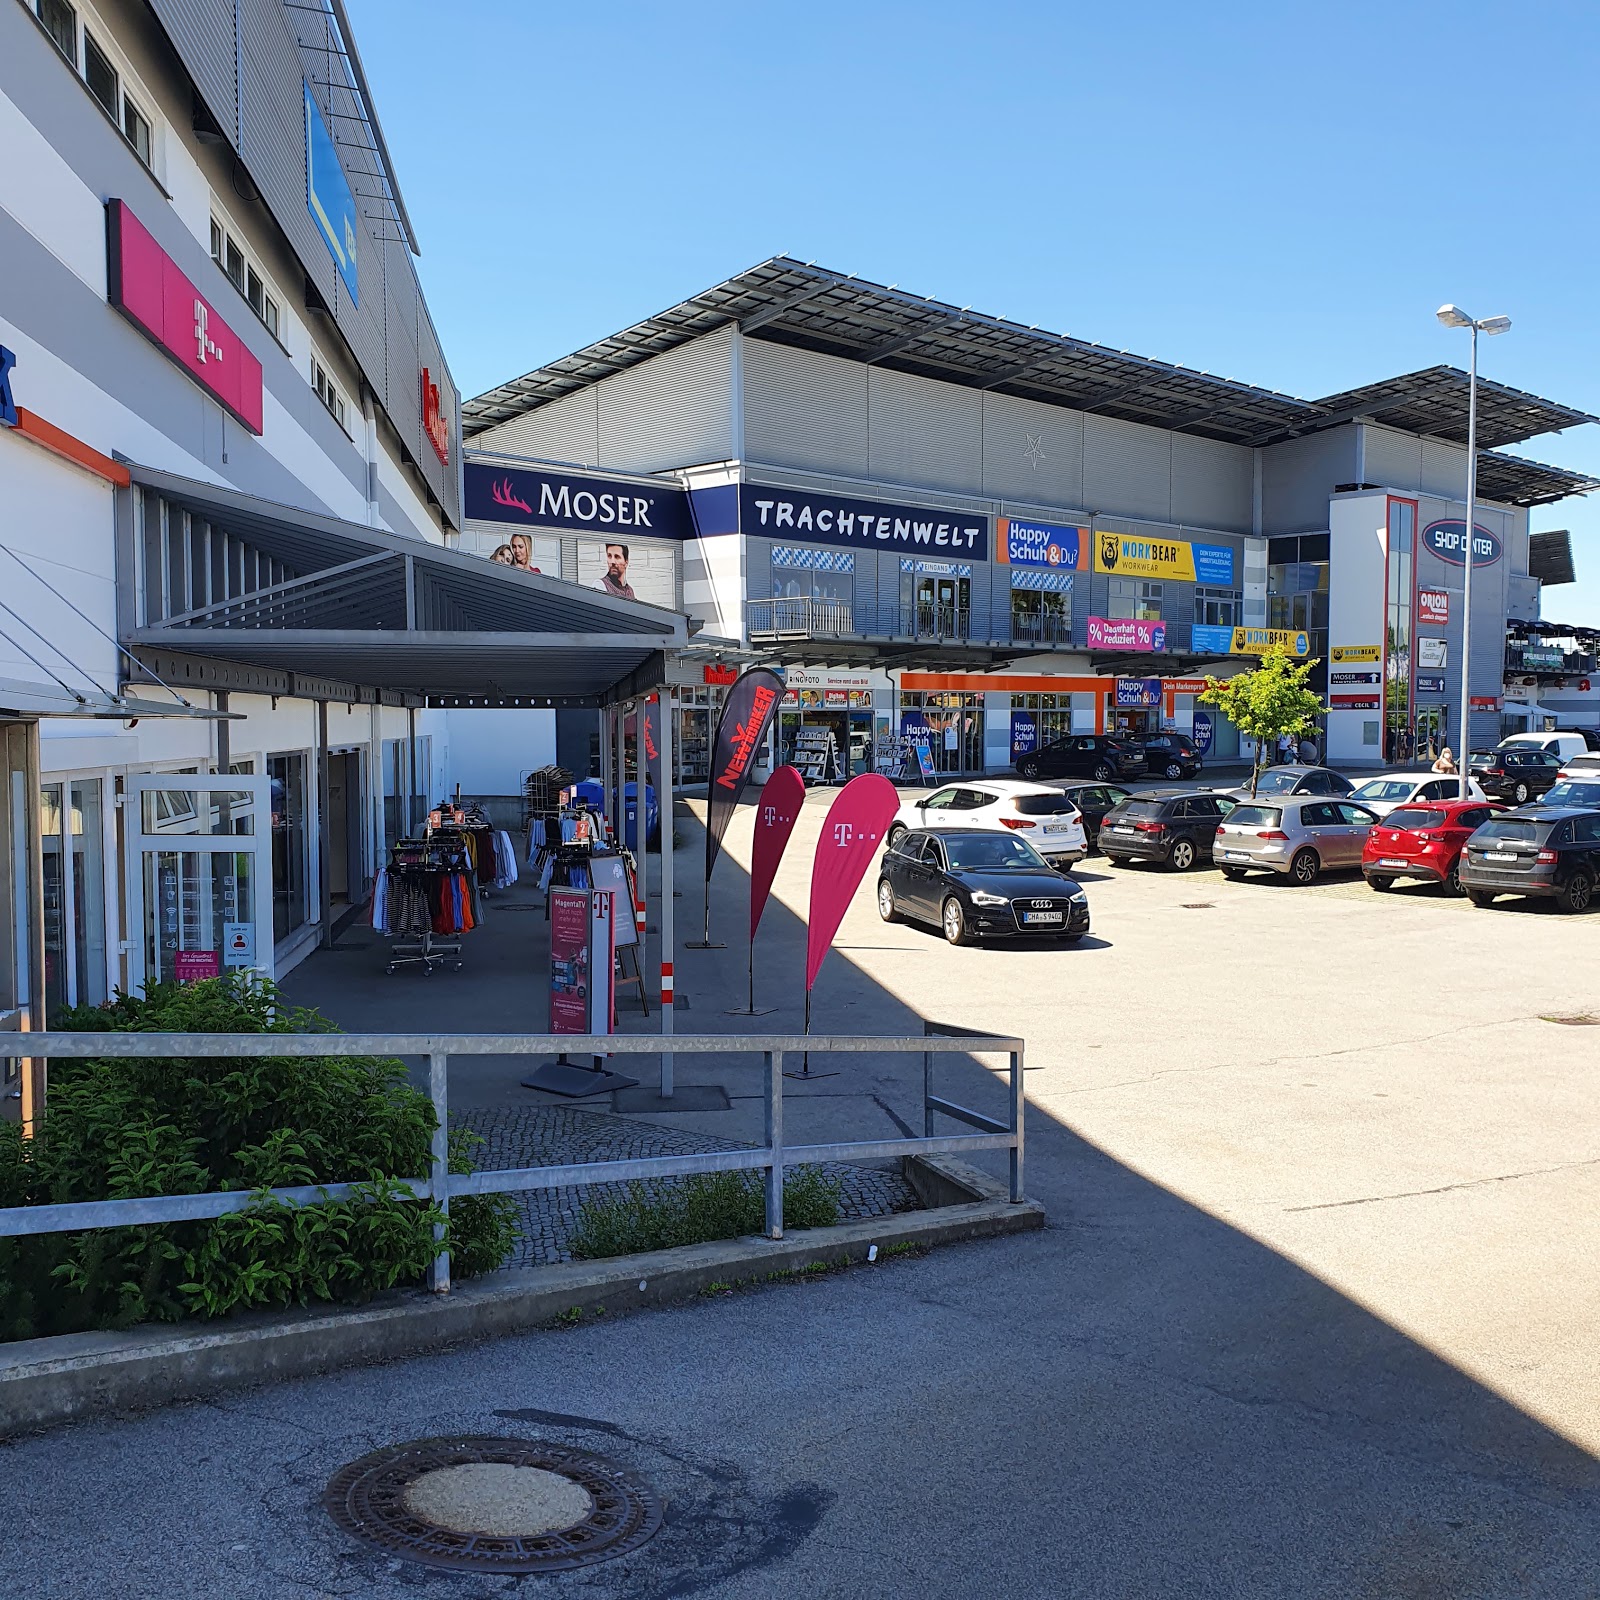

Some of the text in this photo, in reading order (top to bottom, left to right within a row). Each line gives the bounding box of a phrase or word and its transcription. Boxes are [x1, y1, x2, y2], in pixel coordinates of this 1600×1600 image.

[754, 500, 980, 550] TRACHTENWELT
[1010, 523, 1050, 546] Happy
[1434, 530, 1492, 555] SHOP CNTER
[1122, 561, 1159, 572] WORKWEAR
[1420, 593, 1448, 613] ORION
[1103, 632, 1136, 645] reduziert
[827, 677, 842, 685] Service
[1118, 680, 1144, 692] Happy
[1163, 682, 1206, 691] Dein Markenprofi
[1014, 721, 1035, 732] Happy
[1195, 721, 1212, 732] Happy
[1014, 731, 1035, 741] Schuh
[1194, 730, 1211, 739] Schuh
[555, 899, 586, 908] MagentaTV
[1028, 913, 1039, 921] CHA
